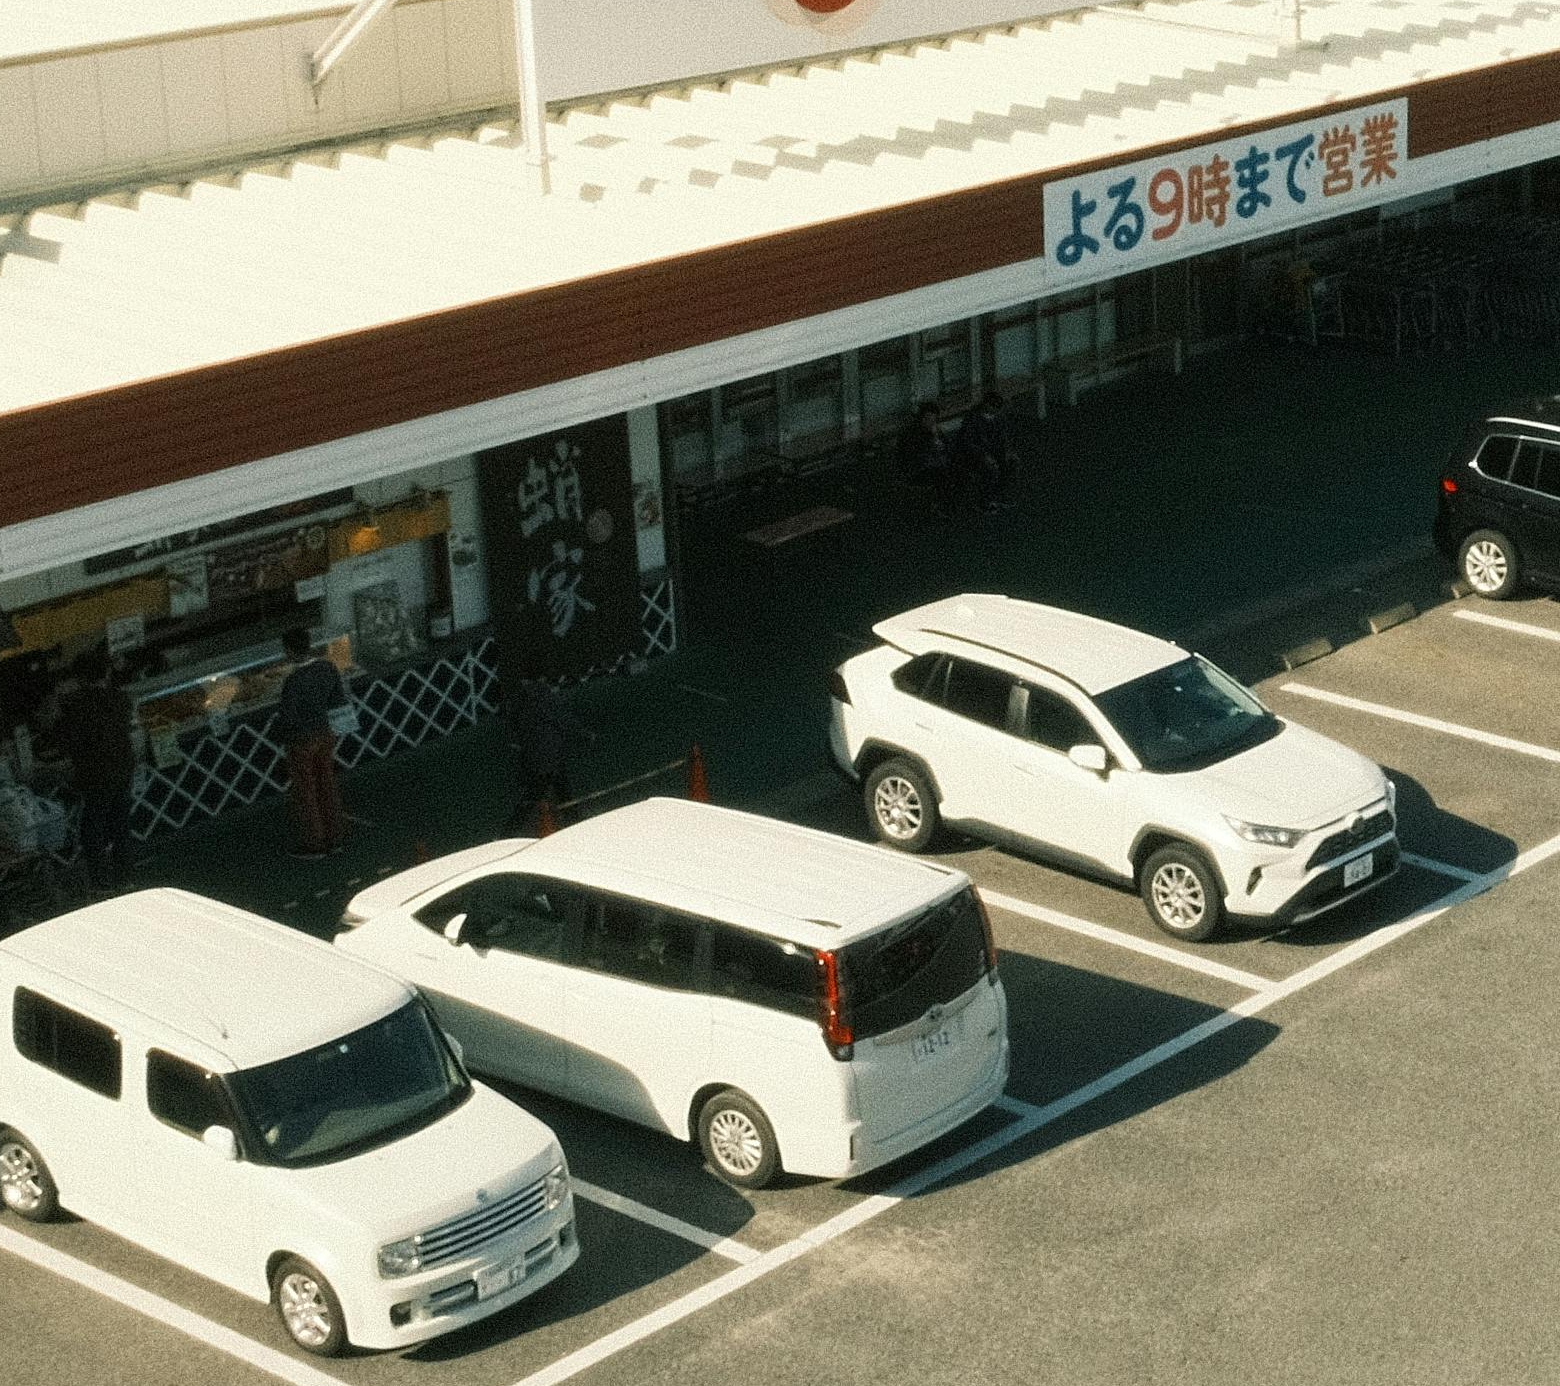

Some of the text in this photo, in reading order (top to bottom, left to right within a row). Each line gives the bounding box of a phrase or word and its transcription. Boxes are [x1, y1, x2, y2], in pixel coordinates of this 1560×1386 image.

[1053, 110, 1401, 268] よる9時まで営業
